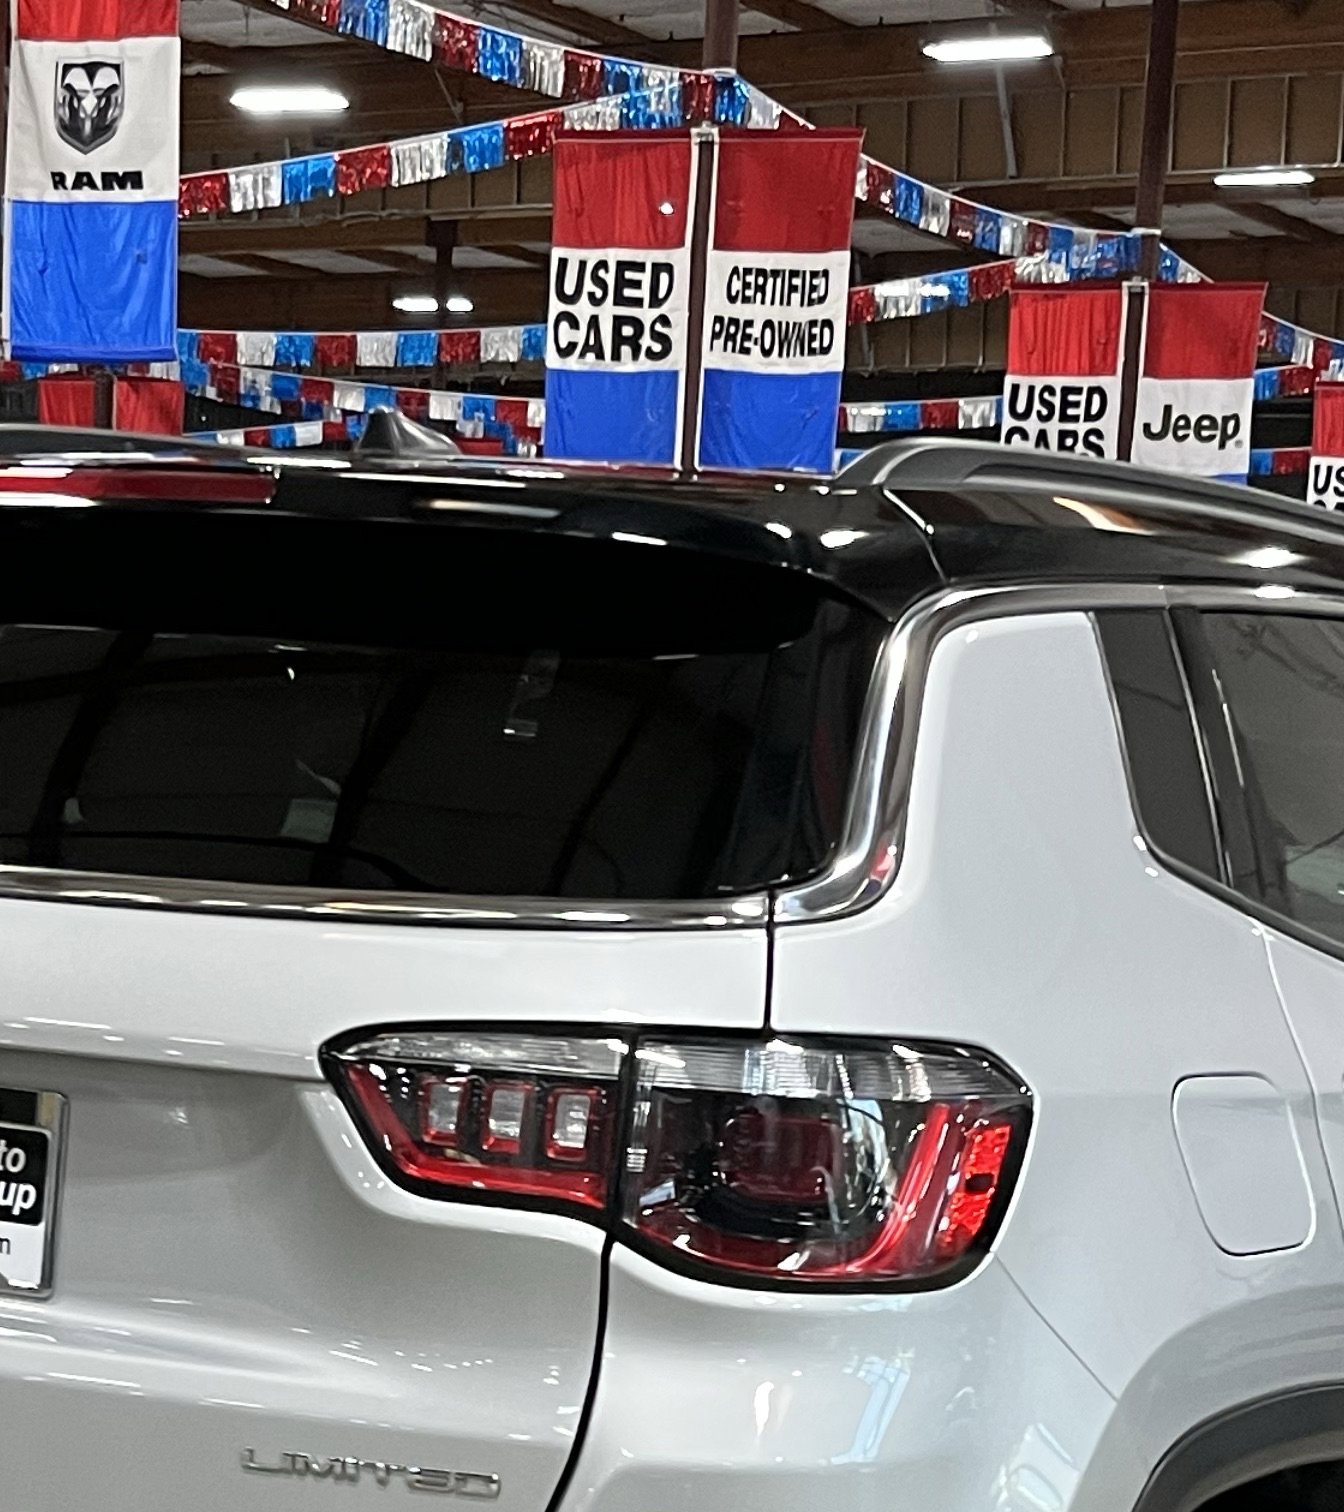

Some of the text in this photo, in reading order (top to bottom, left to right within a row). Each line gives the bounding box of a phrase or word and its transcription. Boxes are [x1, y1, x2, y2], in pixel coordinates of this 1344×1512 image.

[50, 170, 143, 191] RAM
[556, 258, 674, 309] USED
[726, 266, 829, 307] CERTIFIED
[553, 310, 673, 362] CARS
[710, 315, 834, 358] PRE-OWNED
[1008, 383, 1107, 423] USED
[1143, 404, 1241, 450] Jeep
[240, 1446, 501, 1500] LIMITED
